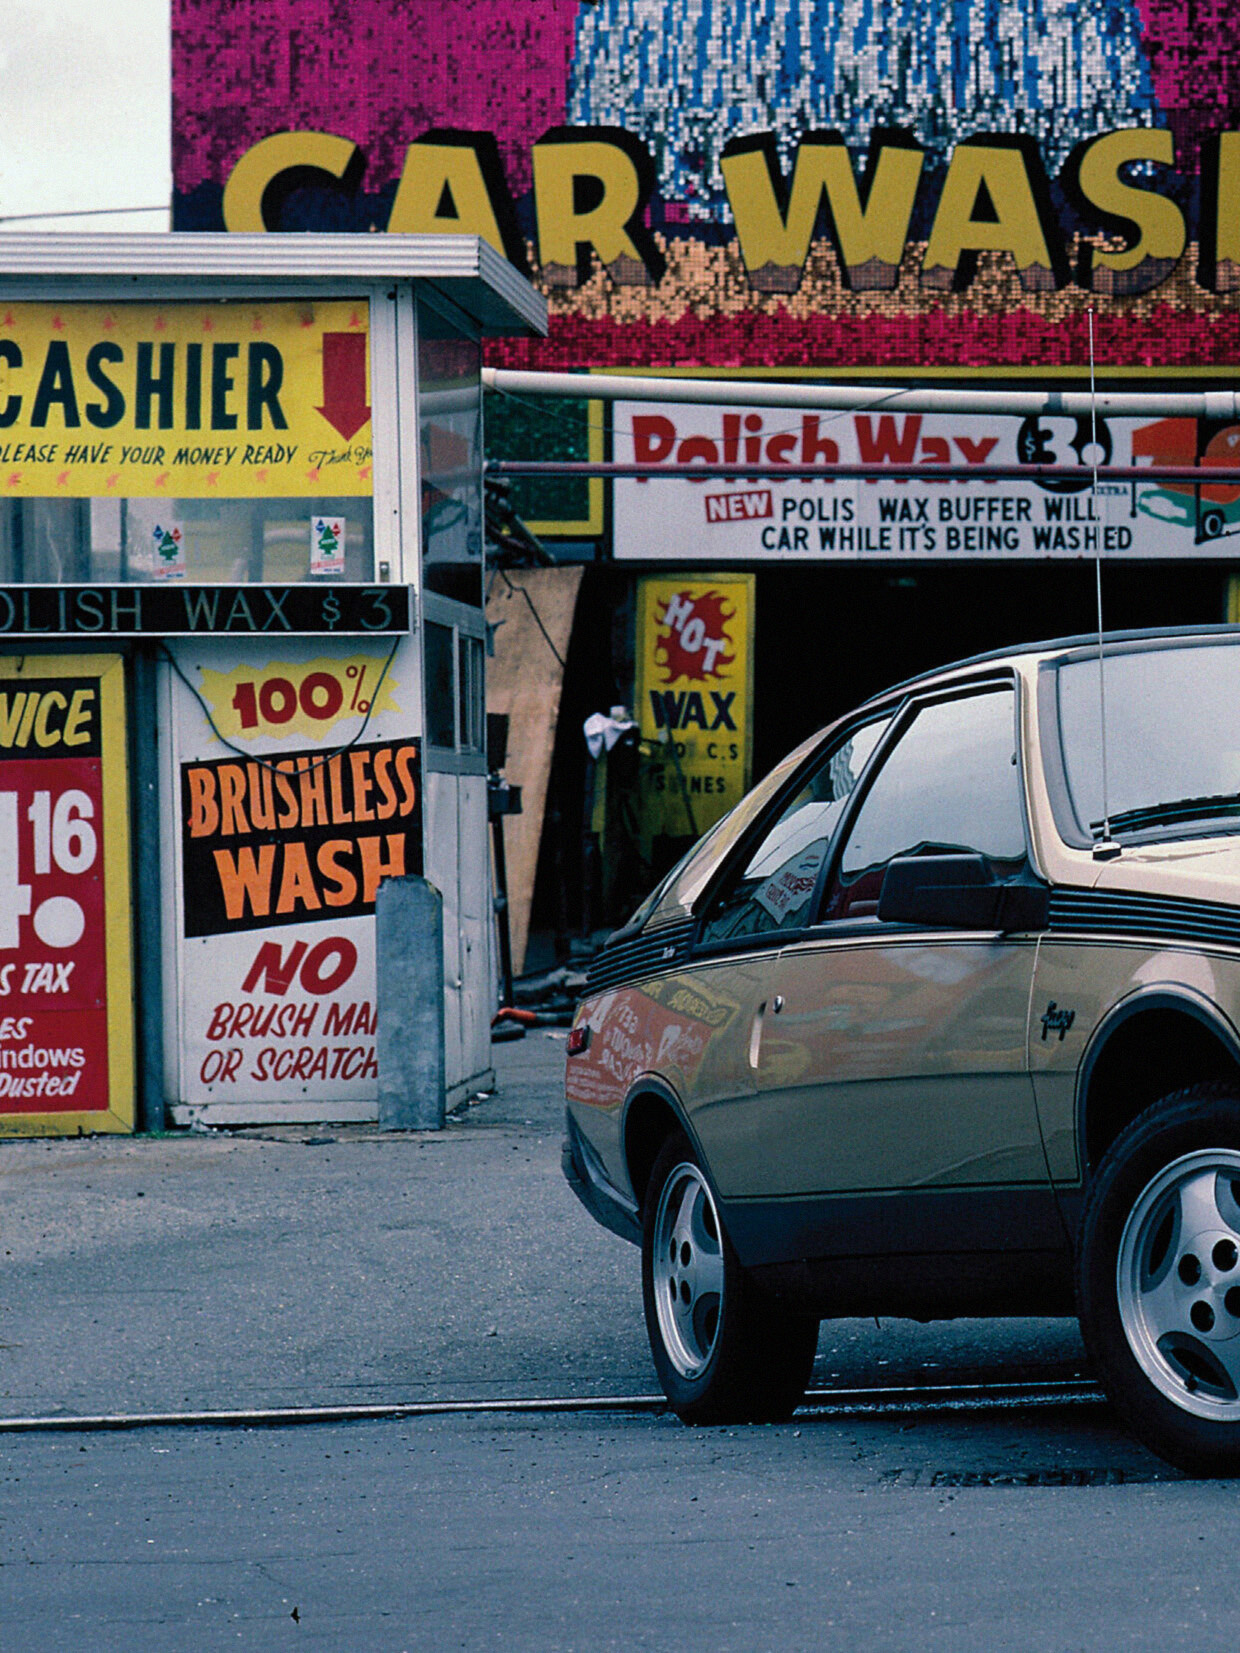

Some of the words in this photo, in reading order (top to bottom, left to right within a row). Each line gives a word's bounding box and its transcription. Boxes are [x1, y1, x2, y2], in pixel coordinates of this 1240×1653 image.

[222, 131, 655, 288] CAR
[0, 340, 289, 430] CASHIER
[0, 444, 58, 463] LEASE
[64, 443, 113, 463] HAVE
[119, 446, 166, 466] YOUR
[173, 446, 238, 465] MONEY
[241, 443, 298, 464] READY
[632, 414, 839, 483] Polish
[854, 415, 998, 483] Wax
[709, 494, 771, 521] NEW
[782, 499, 854, 521] POLIS
[880, 498, 929, 522] WAX
[938, 498, 1032, 521] BUFFER
[1045, 498, 1101, 521] WILL
[761, 527, 808, 551] CAR
[818, 527, 892, 551] WHILE
[900, 523, 937, 551] IT'S
[946, 527, 1019, 551] BEING
[1033, 527, 1133, 550] WASHED
[183, 589, 293, 631] WAX
[663, 594, 726, 672] HOT
[0, 689, 95, 748] VICE
[232, 665, 371, 729] 100%
[650, 690, 738, 731] WAX
[188, 746, 416, 838] BRUSHLESS
[213, 833, 406, 919] WASH
[21, 961, 76, 994] TAX
[241, 936, 358, 996] NO
[206, 1002, 319, 1041] BRUSH
[322, 1001, 378, 1036] MA
[0, 1070, 82, 1098] Dusted
[200, 1049, 243, 1084] OR
